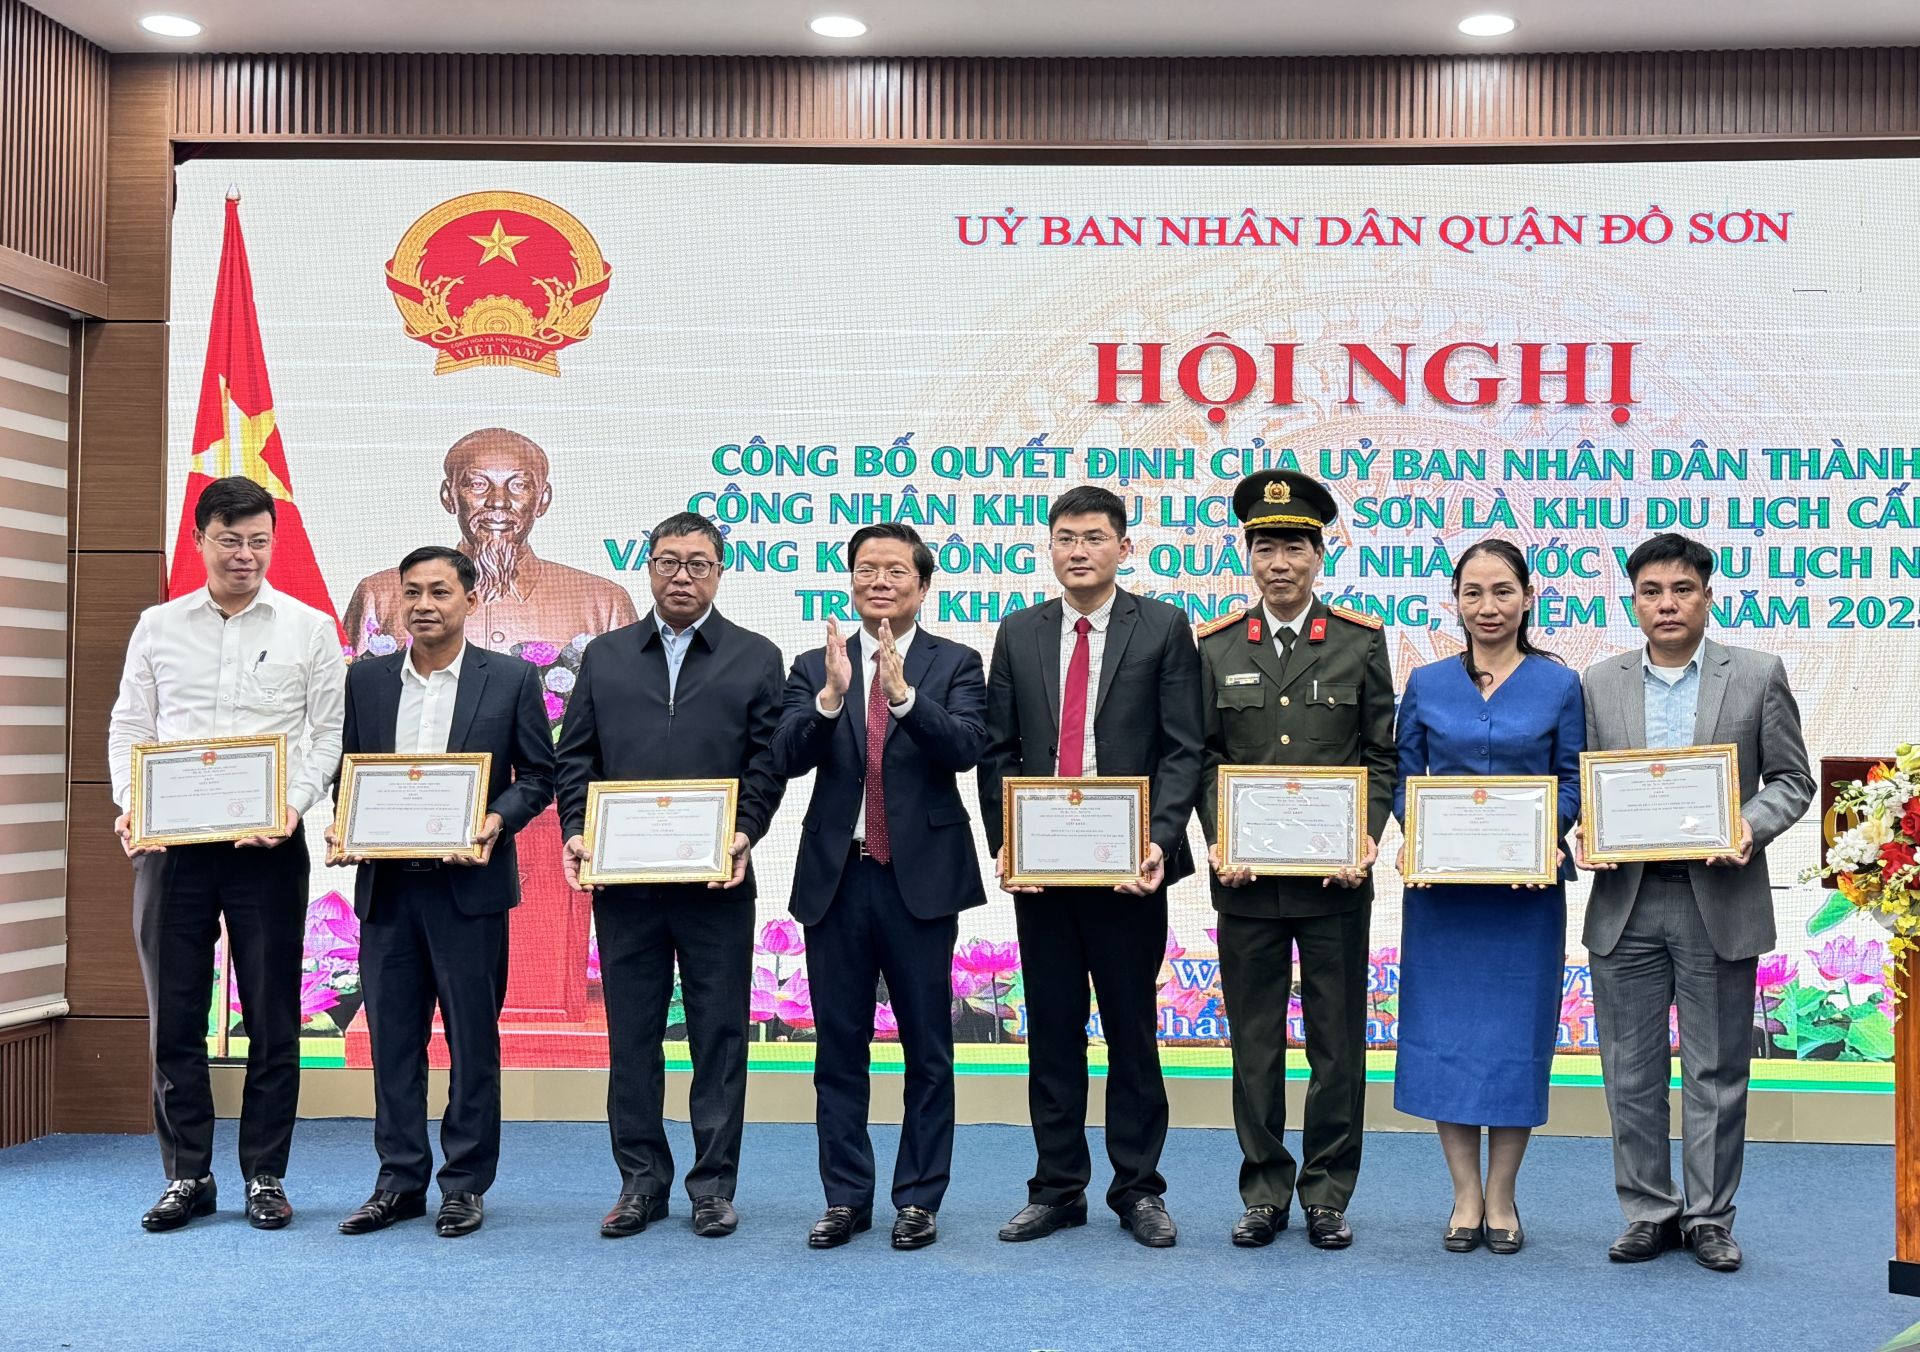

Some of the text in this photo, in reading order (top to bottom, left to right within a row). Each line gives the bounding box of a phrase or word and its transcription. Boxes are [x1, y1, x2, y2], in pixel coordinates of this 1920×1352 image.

[954, 204, 1793, 254] UỶ BAN NHÂN DÂN QUẬN ĐỒ SƠN
[500, 344, 538, 360] NAM
[1088, 331, 1643, 425] HỘI NGHỊ
[712, 432, 1920, 486] CÔNG BỐ QUYẾT ĐỊNH CỦA UỶ BAN NHÂN DÂN THÀNH
[687, 483, 814, 525] CÔNG
[829, 484, 957, 526] NHÂN
[1353, 497, 1446, 529] SƠN
[1461, 487, 1519, 529] LÀ
[1533, 497, 1629, 529] KHU
[1646, 497, 1710, 529] DU
[1728, 496, 1830, 537] LỊCH
[1847, 482, 1920, 529] CẤ
[1149, 534, 1252, 578] QUẢ
[1359, 537, 1455, 577] NHÀ
[1768, 546, 1872, 587] LỊCH
[1708, 590, 1811, 629] NĂM
[1827, 596, 1920, 629] 202
